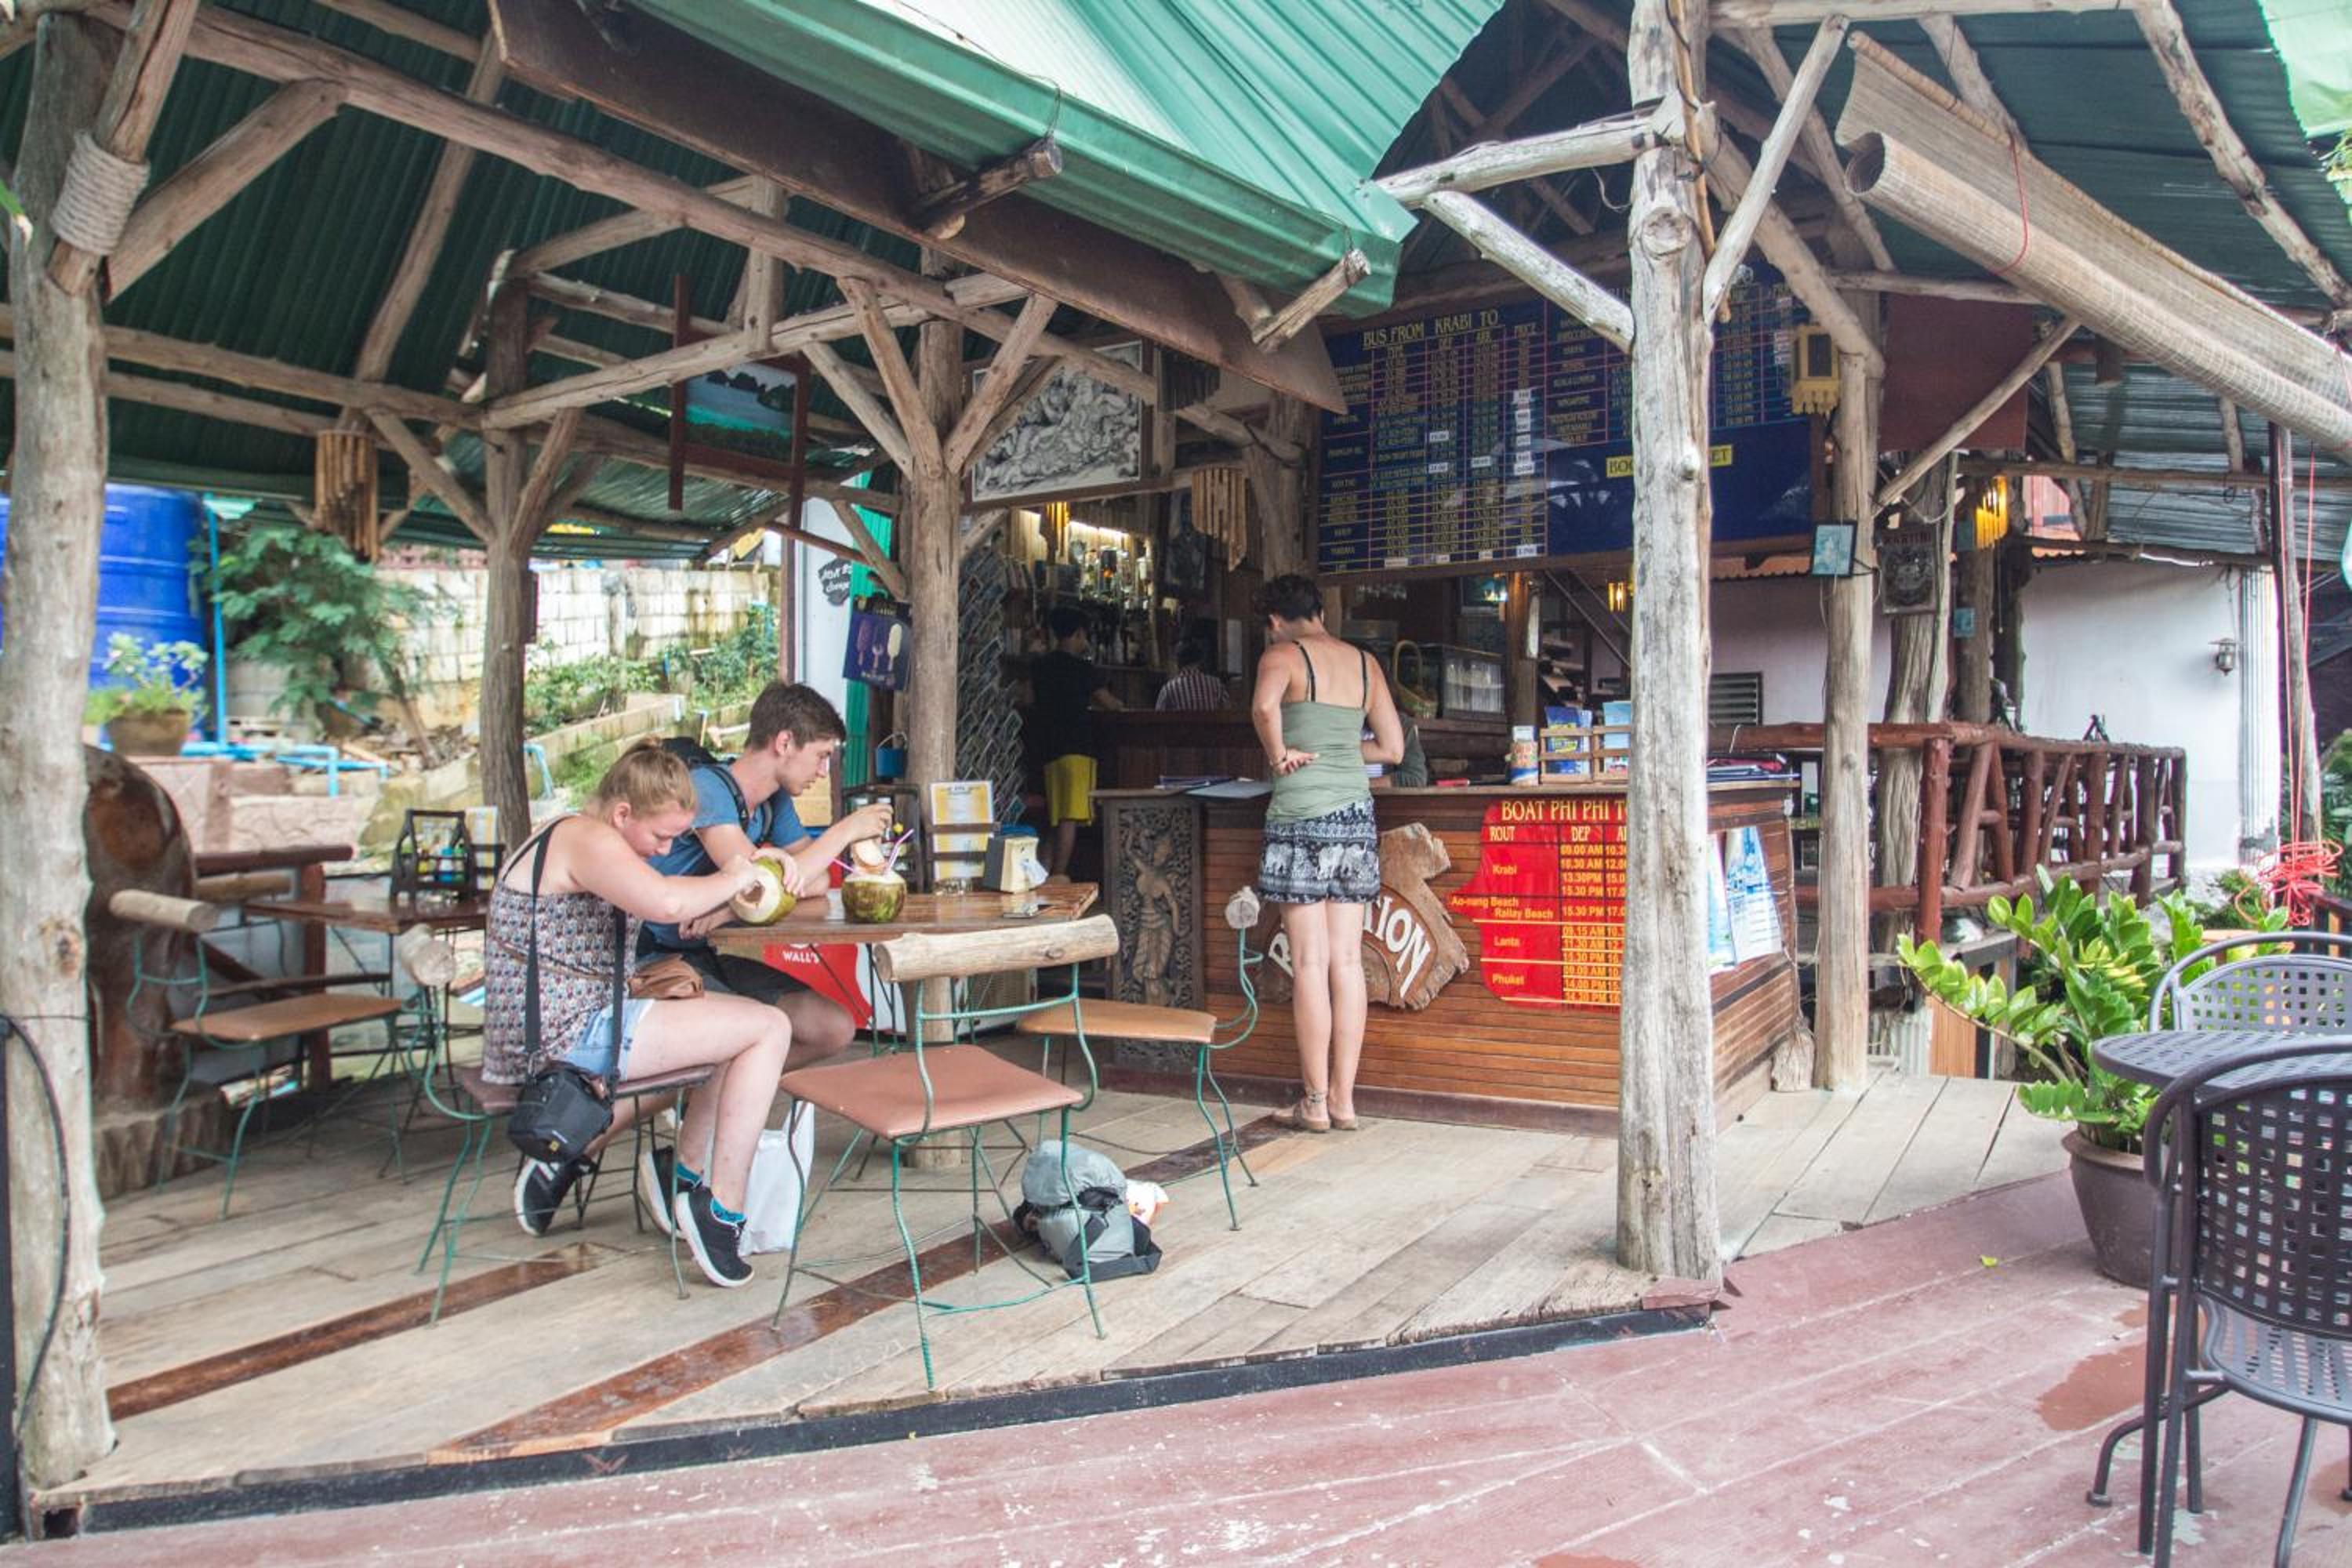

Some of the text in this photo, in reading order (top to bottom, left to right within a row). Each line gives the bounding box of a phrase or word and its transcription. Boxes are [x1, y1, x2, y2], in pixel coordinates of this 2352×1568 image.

[1363, 309, 1499, 347] BUS FROM KRABI TO
[1501, 800, 1628, 822] BOAT PHI PHI T
[1490, 826, 1515, 841] ROUT
[1571, 826, 1591, 841] DEP
[1587, 844, 1603, 856] AM
[1492, 864, 1518, 876] Krabi
[1586, 858, 1603, 870] AM
[1587, 886, 1604, 897] PM
[1490, 896, 1519, 907] Beach
[1524, 908, 1554, 920] Beach
[1588, 906, 1605, 917] PM
[1588, 926, 1606, 937] AM
[1494, 935, 1521, 947] Lanta
[1589, 938, 1606, 950] AM
[1589, 952, 1606, 964] PM
[1590, 966, 1606, 978] AM
[1492, 973, 1525, 985] Phuket
[1591, 979, 1606, 991] PM
[1591, 993, 1607, 1004] PM
